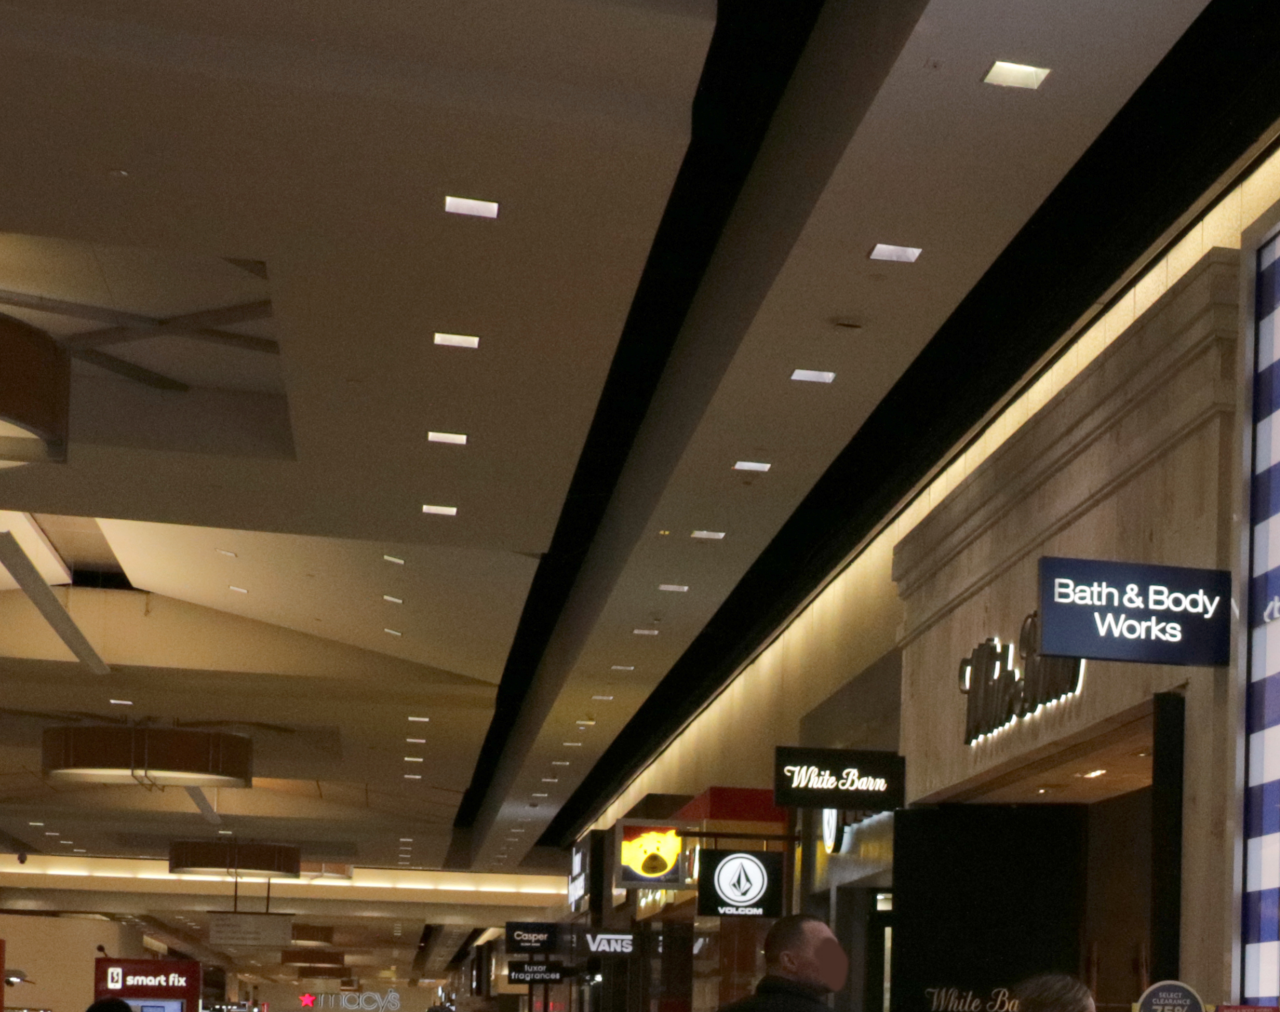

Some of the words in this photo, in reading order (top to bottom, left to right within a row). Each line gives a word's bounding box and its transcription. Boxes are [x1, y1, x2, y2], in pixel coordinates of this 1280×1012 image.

[1053, 577, 1120, 607] Bath
[1122, 583, 1145, 609] &
[1148, 585, 1220, 619] Body
[1094, 611, 1183, 643] Works
[783, 765, 838, 790] White
[838, 767, 888, 792] Barn
[717, 906, 763, 916] VOLCOM
[513, 930, 548, 943] Casper
[586, 933, 634, 953] VANS
[510, 971, 561, 981] fragrances
[524, 964, 547, 972] luxor
[125, 974, 167, 986] smart
[168, 973, 187, 987] fix
[925, 987, 982, 1012] White
[986, 987, 1020, 1012] Ba
